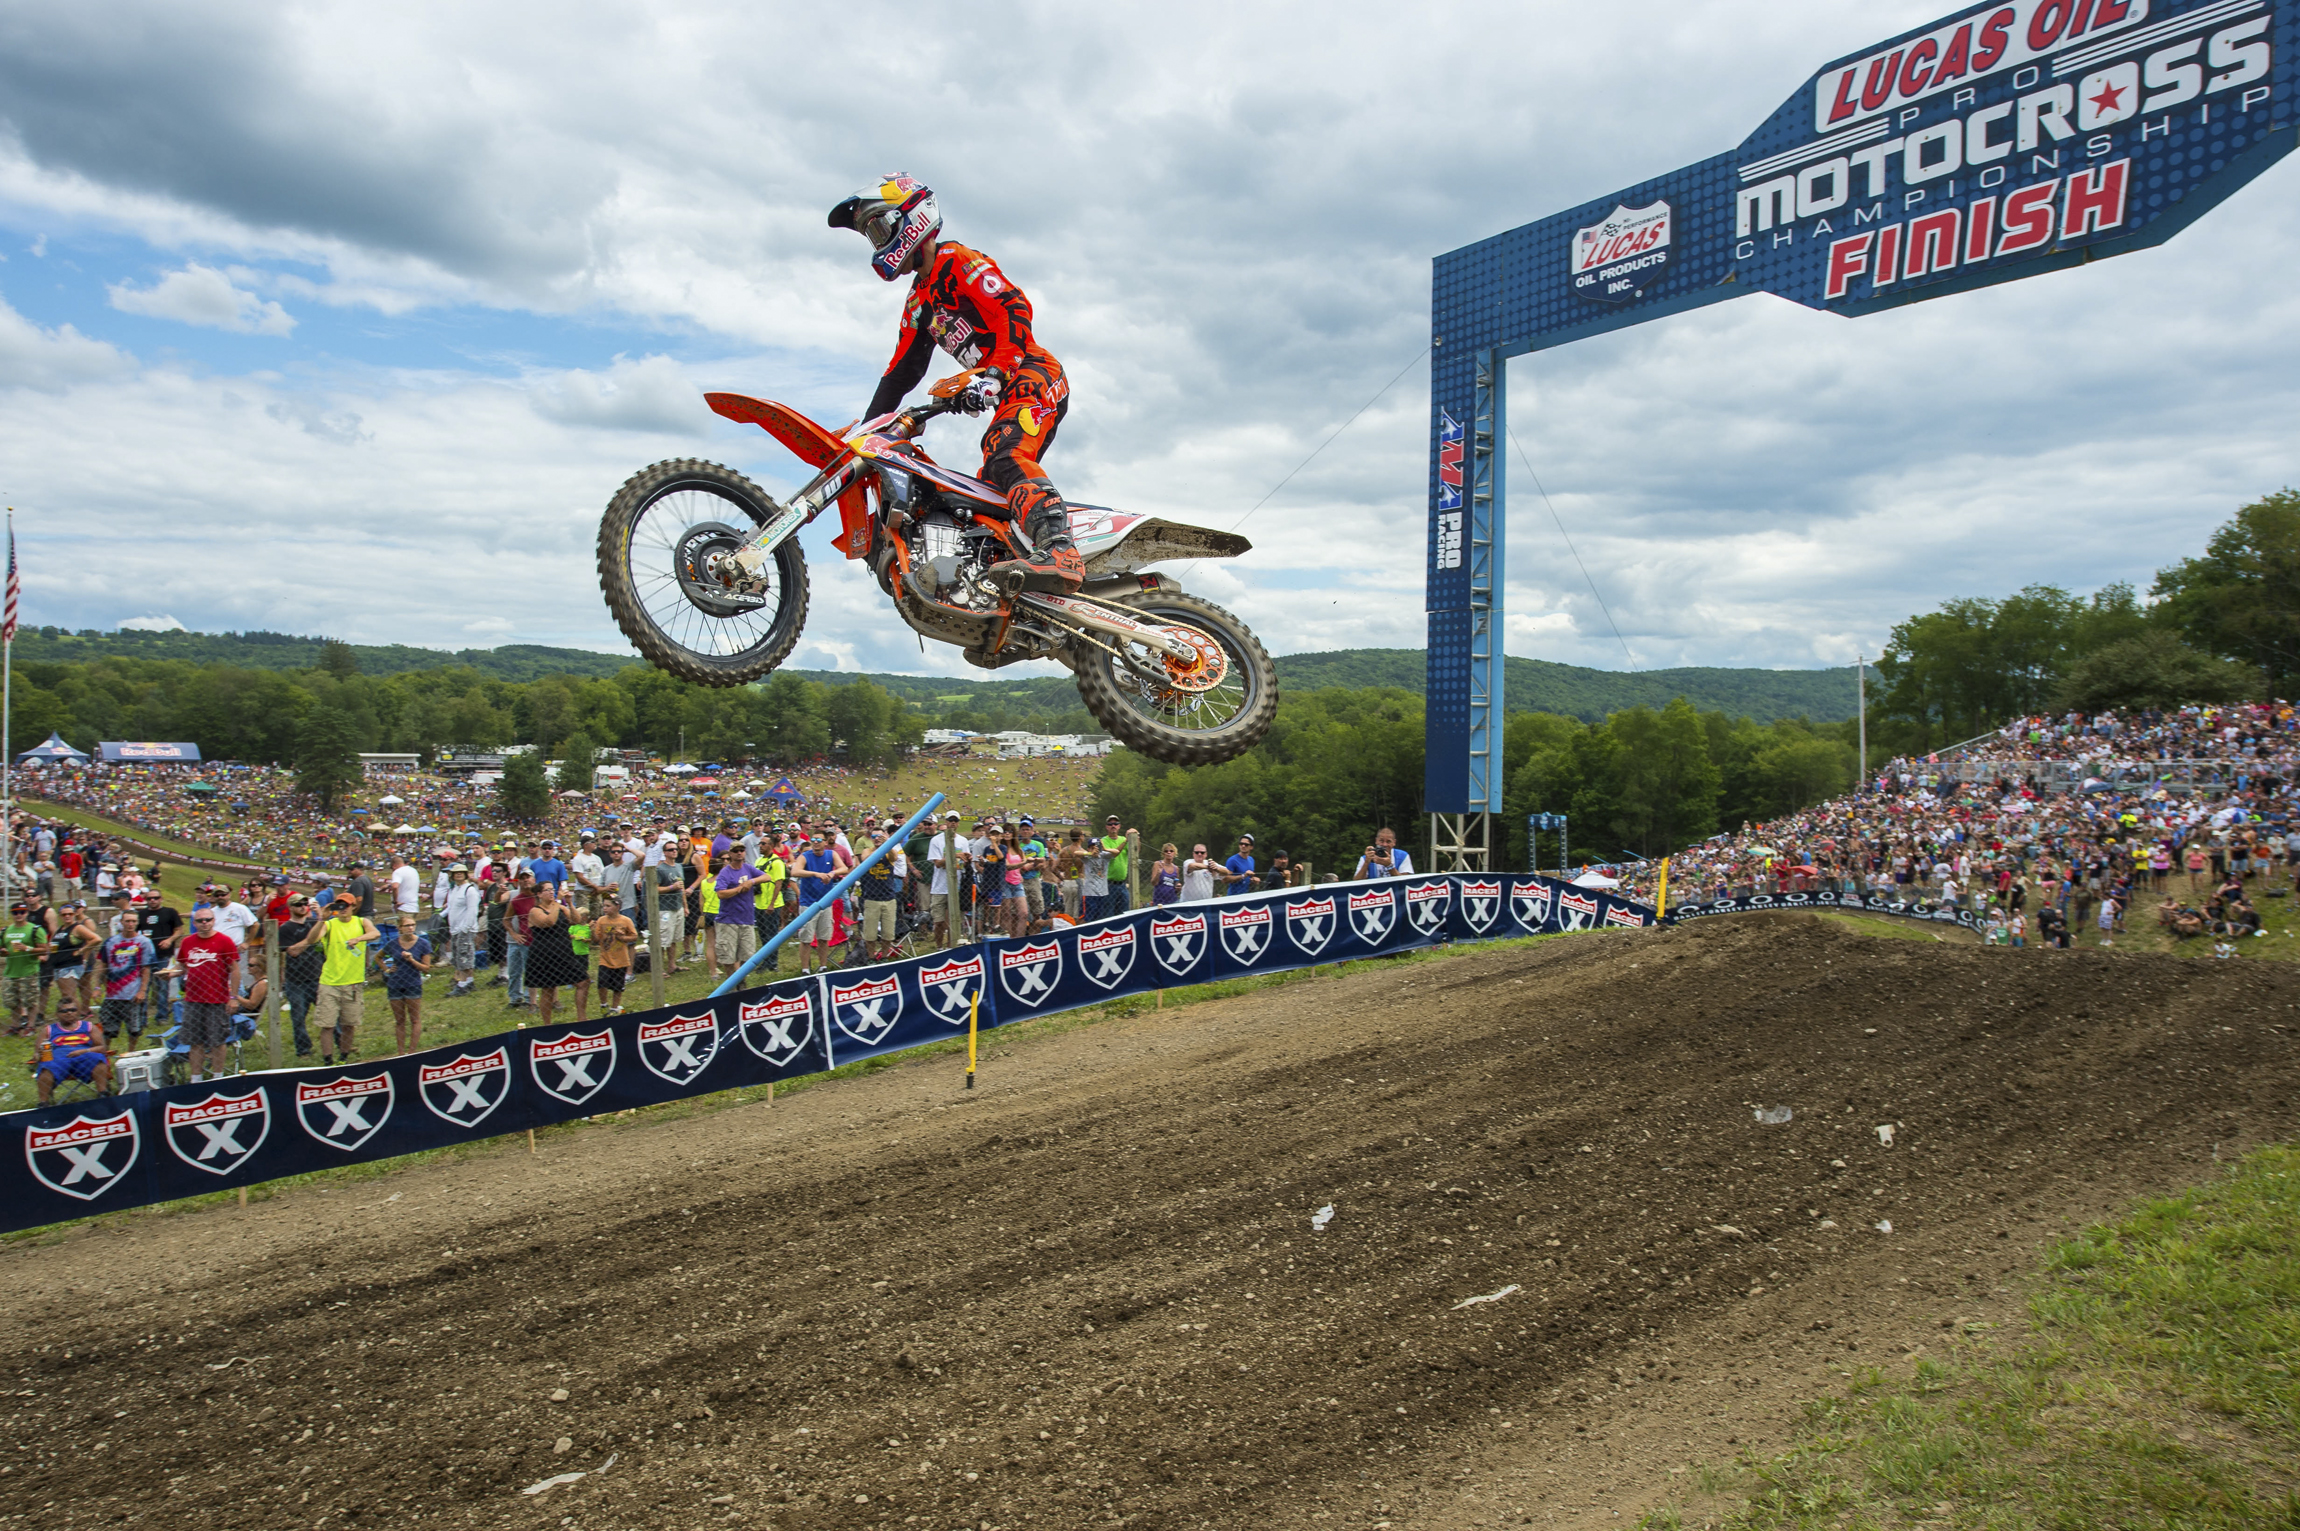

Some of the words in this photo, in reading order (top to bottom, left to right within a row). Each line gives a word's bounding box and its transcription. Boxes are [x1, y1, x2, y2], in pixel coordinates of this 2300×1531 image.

[1828, 4, 2015, 125] LUCAS
[1900, 65, 2039, 129] PRO
[1736, 14, 2271, 238] MOTOCROSS
[1735, 86, 2271, 259] CHAMPIONSHIP
[904, 211, 931, 241] Bull
[1824, 157, 2131, 299] FINISH
[1581, 221, 1665, 270] LUCAS
[1575, 274, 1597, 288] OIL
[1599, 251, 1667, 282] PRODUCTS
[1607, 279, 1634, 295] INC.
[1438, 405, 1465, 511] AMA
[768, 511, 802, 539] MOTOREX
[1437, 514, 1446, 570] RACING
[1445, 511, 1463, 569] PRO
[1047, 595, 1066, 606] DID
[1351, 896, 1391, 908] RACER
[1409, 888, 1447, 900] RACER
[1514, 887, 1548, 899] RACER
[1562, 897, 1594, 912] RACER
[1223, 913, 1268, 926] RACER
[1290, 904, 1331, 917] RACER
[1361, 907, 1386, 935] X
[1416, 899, 1440, 925] X
[1470, 899, 1490, 922] X
[1521, 899, 1542, 921] X
[1565, 909, 1586, 932] X
[1081, 932, 1132, 951] RACER
[1155, 921, 1203, 935] RACER
[1234, 926, 1260, 954] X
[1300, 917, 1325, 944] X
[1003, 947, 1057, 967] RACER
[1094, 947, 1124, 978] X
[1166, 934, 1194, 964] X
[924, 963, 979, 983] RACER
[1016, 963, 1048, 996] X
[836, 982, 895, 1003] RACER
[938, 979, 973, 1013] X
[744, 1001, 807, 1020] RACER
[851, 998, 888, 1033] X
[644, 1019, 710, 1039] RACER
[762, 1017, 798, 1053] X
[536, 1037, 607, 1058] RACER
[661, 1035, 701, 1072] X
[425, 1058, 500, 1081] RACER
[554, 1054, 598, 1091] X
[303, 1080, 383, 1100] RACER
[445, 1074, 490, 1114] X
[172, 1099, 258, 1123] RACER
[324, 1096, 373, 1137] X
[34, 1123, 126, 1147] RACER
[194, 1118, 247, 1160] X
[58, 1142, 115, 1186] X
